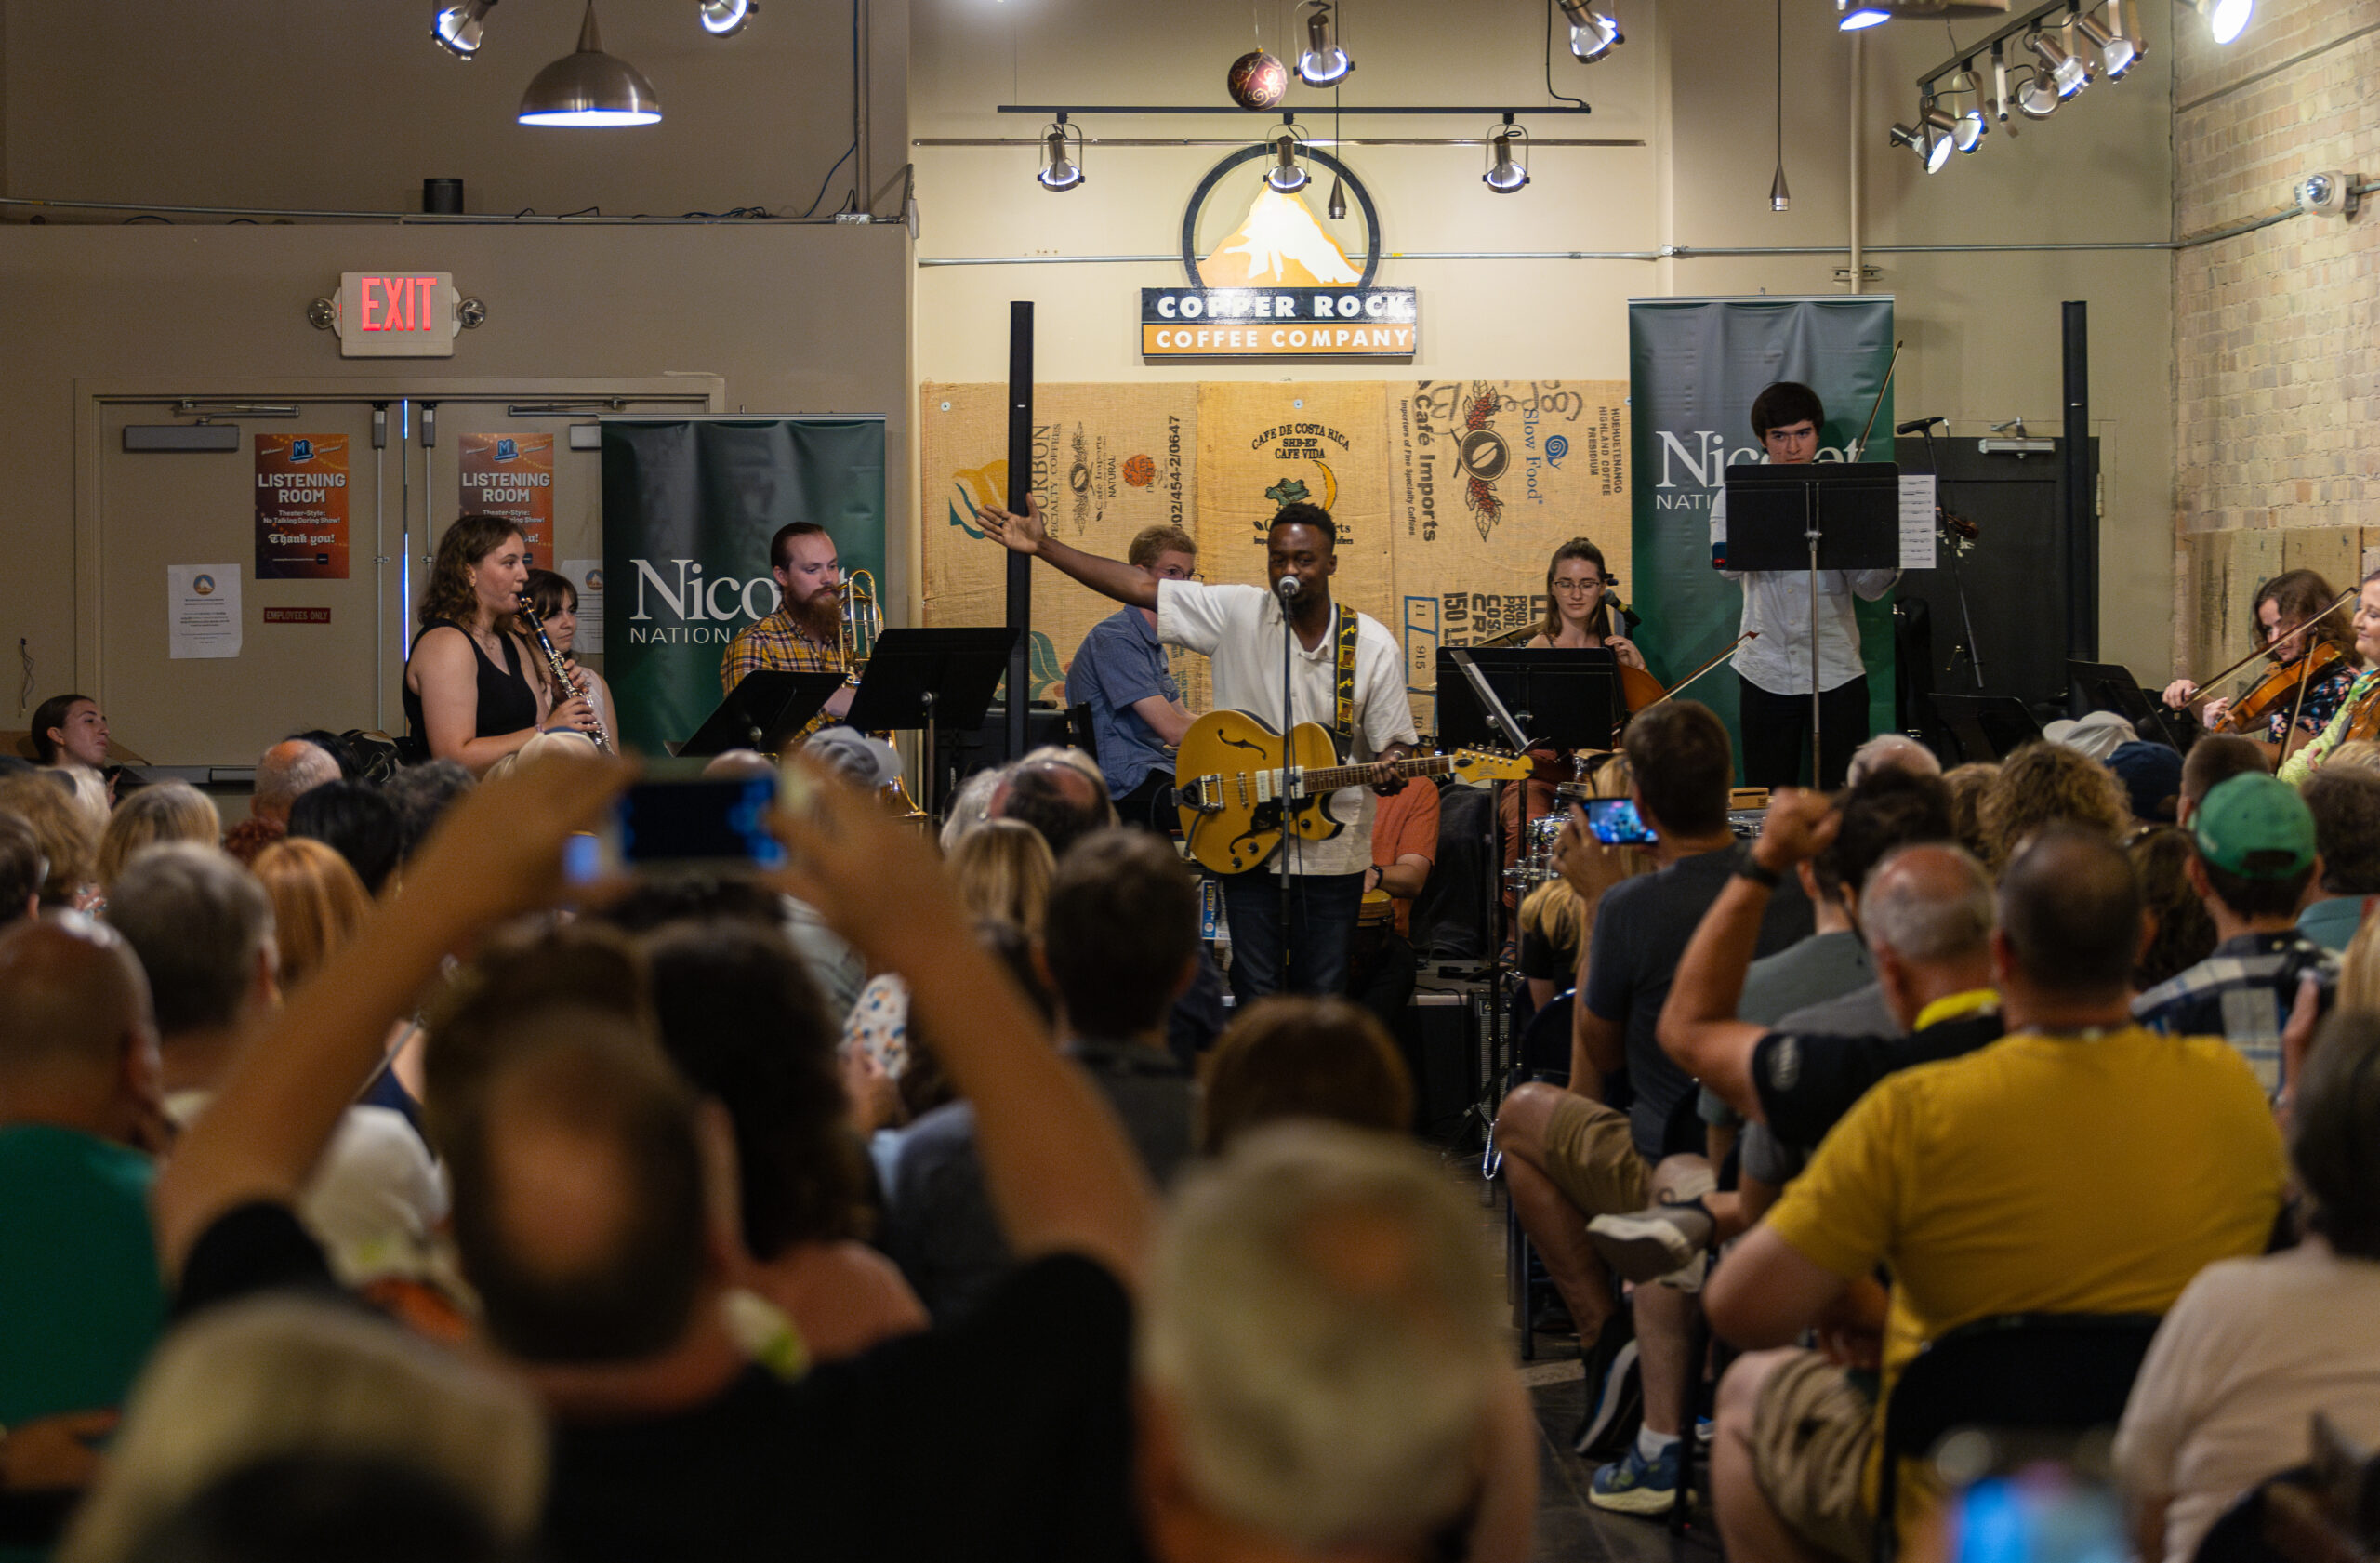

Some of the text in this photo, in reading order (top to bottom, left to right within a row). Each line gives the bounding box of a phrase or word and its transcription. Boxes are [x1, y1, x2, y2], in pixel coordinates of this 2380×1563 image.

[362, 277, 437, 331] EXIT
[1157, 295, 1409, 318] COPPER ROCK
[1157, 329, 1409, 348] COFFEE COMPANY
[1251, 423, 1350, 451] CAFE DE COSTA RICA
[1283, 438, 1318, 447] SHB-EP
[1275, 448, 1326, 459] CAFE VIDA
[1524, 409, 1542, 499] Slow Food
[1587, 427, 1598, 476] PRESIDIUM
[1599, 406, 1611, 496] HIGHLAND COFFEE
[1611, 408, 1622, 493] HUEHUETENANGO
[258, 473, 346, 487] LISTENING
[462, 472, 550, 487] LISTENING
[1032, 425, 1051, 526] URBON
[1107, 455, 1117, 498] NATURAL
[1414, 394, 1438, 542] Café Imports
[279, 489, 325, 503] ROOM
[483, 488, 530, 502] ROOM
[1656, 495, 1711, 509] NATI
[1049, 479, 1059, 539] PECIALTY
[268, 533, 335, 546] Thank you!
[266, 610, 328, 619] EMPLOYEES ONLY
[1443, 592, 1468, 622] 150
[1415, 645, 1426, 669] 915
